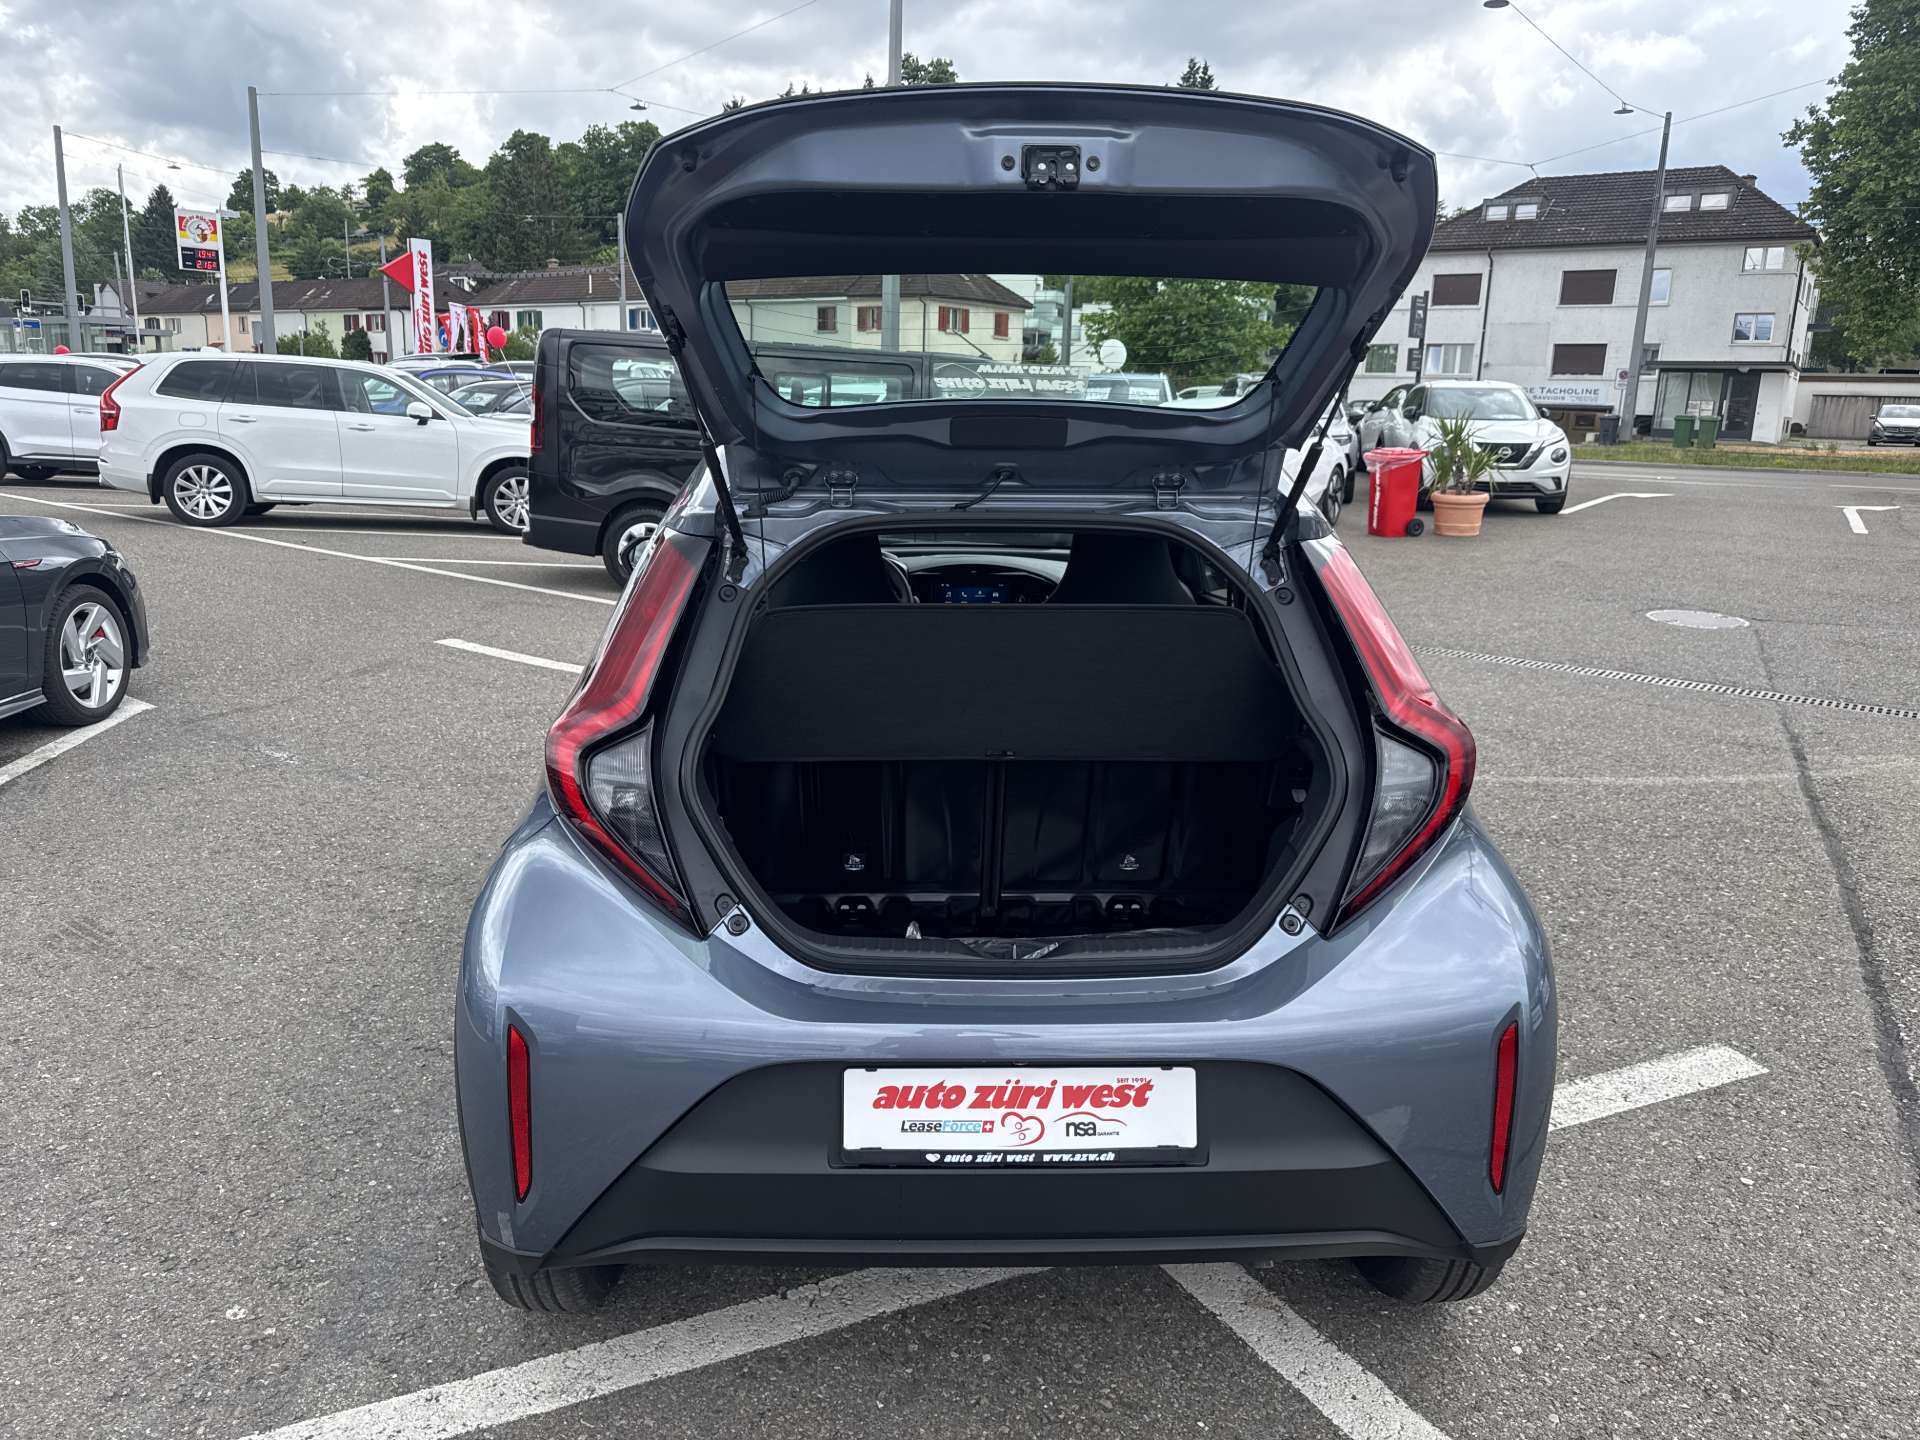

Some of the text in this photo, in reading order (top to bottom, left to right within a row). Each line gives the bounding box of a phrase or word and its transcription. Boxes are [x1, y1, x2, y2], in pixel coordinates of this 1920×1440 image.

[417, 250, 429, 288] west
[1540, 386, 1600, 396] TACHOLINE
[873, 1079, 1154, 1109] auto züri west
[901, 1120, 981, 1134] LeaseForce
[1065, 1121, 1097, 1137] nsa
[944, 1151, 1116, 1163] auto züri west www.azw.ch
